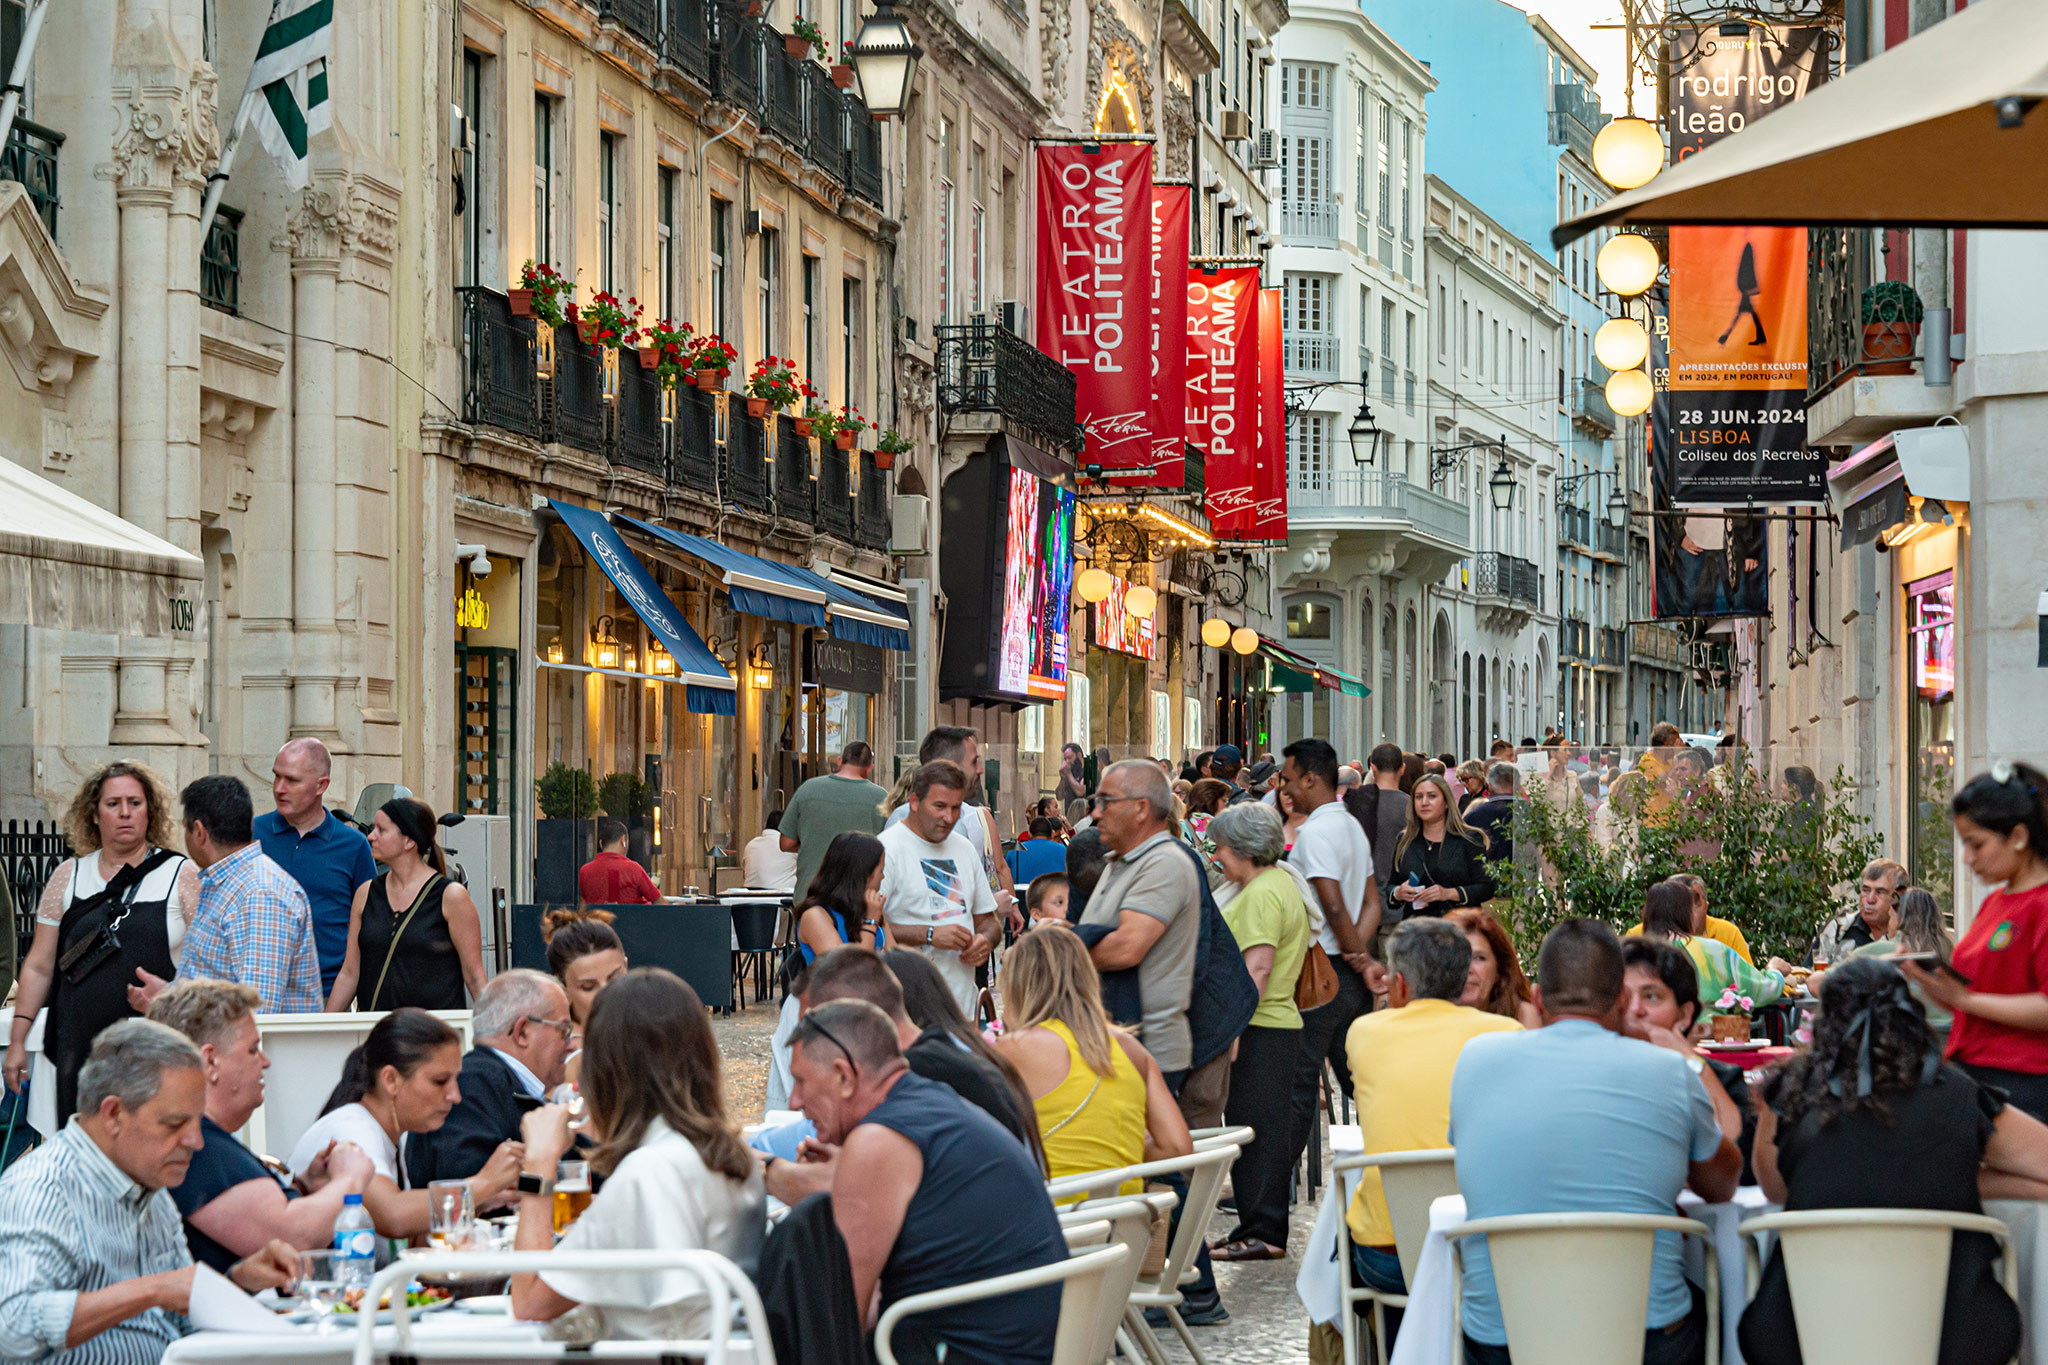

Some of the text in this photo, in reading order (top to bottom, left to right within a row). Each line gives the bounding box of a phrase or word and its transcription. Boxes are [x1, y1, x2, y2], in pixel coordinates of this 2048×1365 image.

[1679, 68, 1796, 105] rodrigo
[1679, 104, 1746, 134] leão
[1062, 163, 1091, 368] TEATRO
[1094, 159, 1124, 373] POLITEAMA
[1185, 282, 1209, 450] TEATRO
[1210, 279, 1236, 455] POLITEAMA
[1678, 362, 1759, 373] APRESENTAÇÕES
[1696, 374, 1721, 382] 2024,
[1740, 373, 1794, 381] PORTUGAL!
[1679, 409, 1806, 425] 28 JUN.2024
[1679, 430, 1751, 445] LISBOA
[1678, 450, 1820, 462] Coliseu dos Recreios
